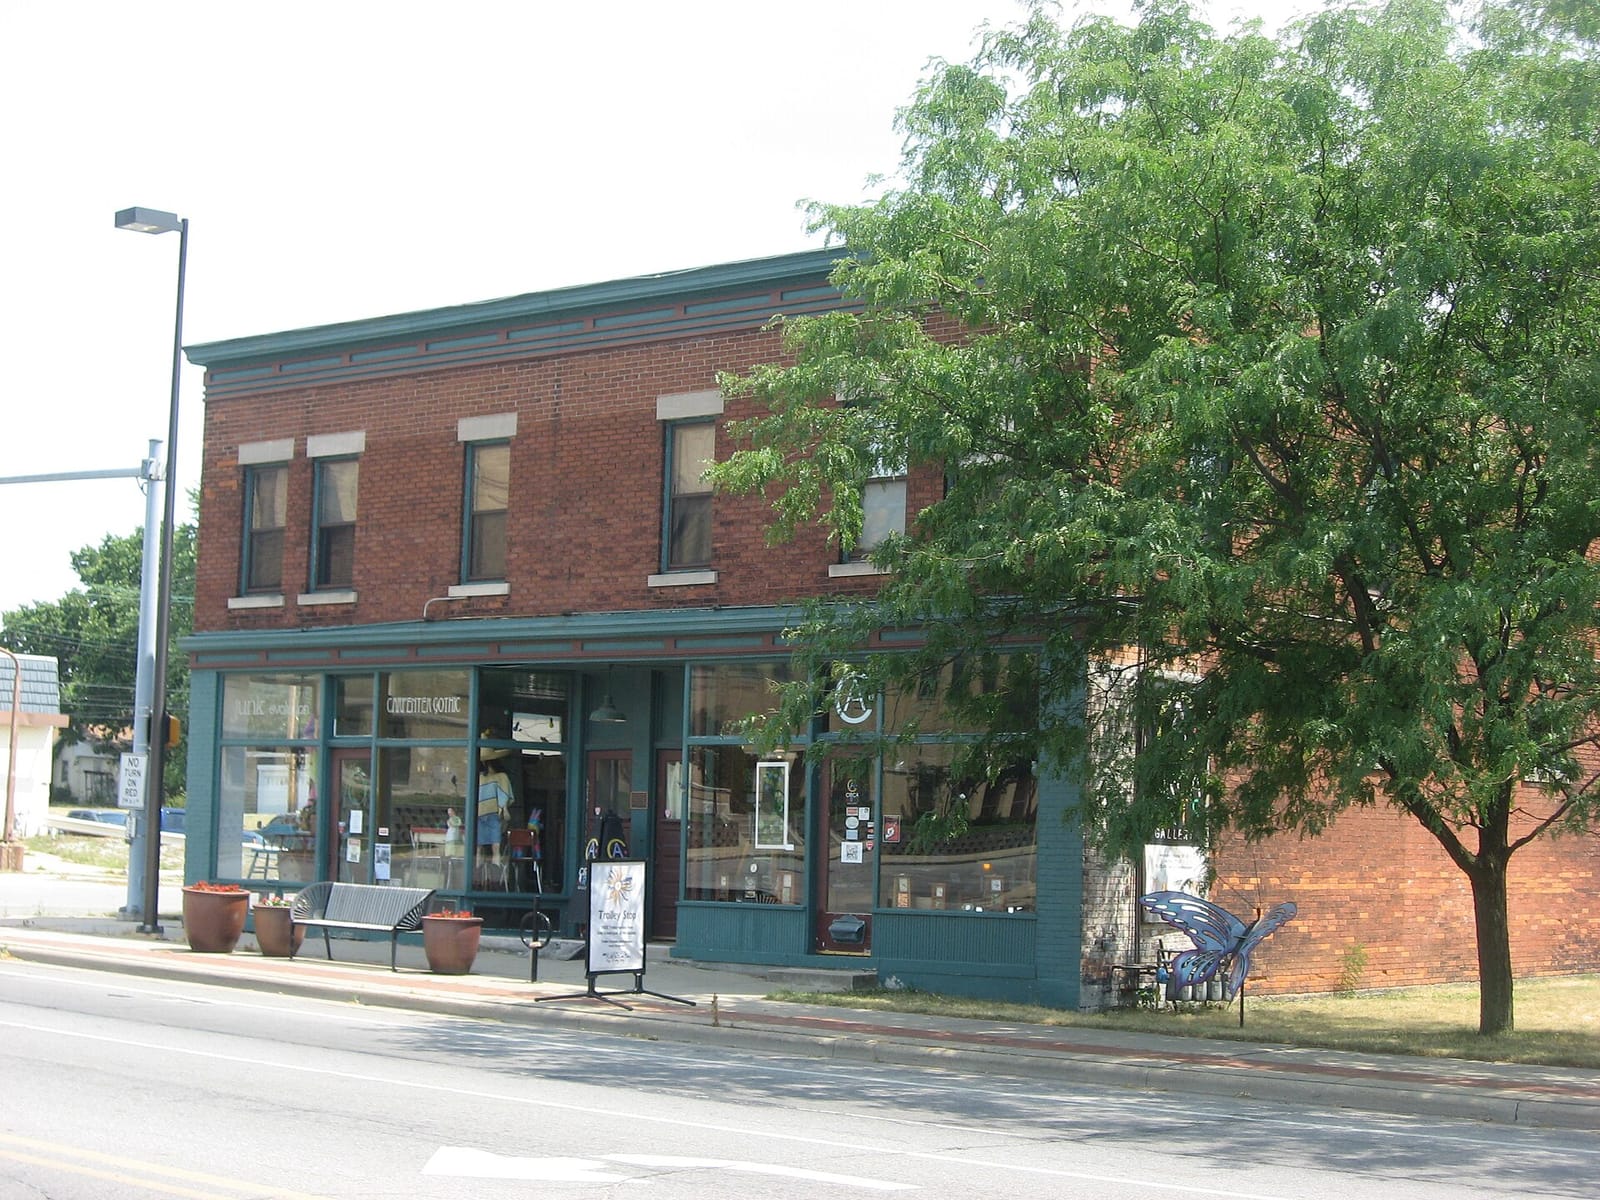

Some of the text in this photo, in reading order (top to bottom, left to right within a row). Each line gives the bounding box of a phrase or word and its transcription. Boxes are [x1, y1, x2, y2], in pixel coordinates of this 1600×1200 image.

[386, 696, 461, 715] CARPENTER GOTHIC
[127, 756, 140, 768] NO
[124, 767, 142, 777] TURN
[127, 778, 137, 787] ON
[124, 787, 138, 798] RED
[598, 910, 637, 921] Trolley Stop
